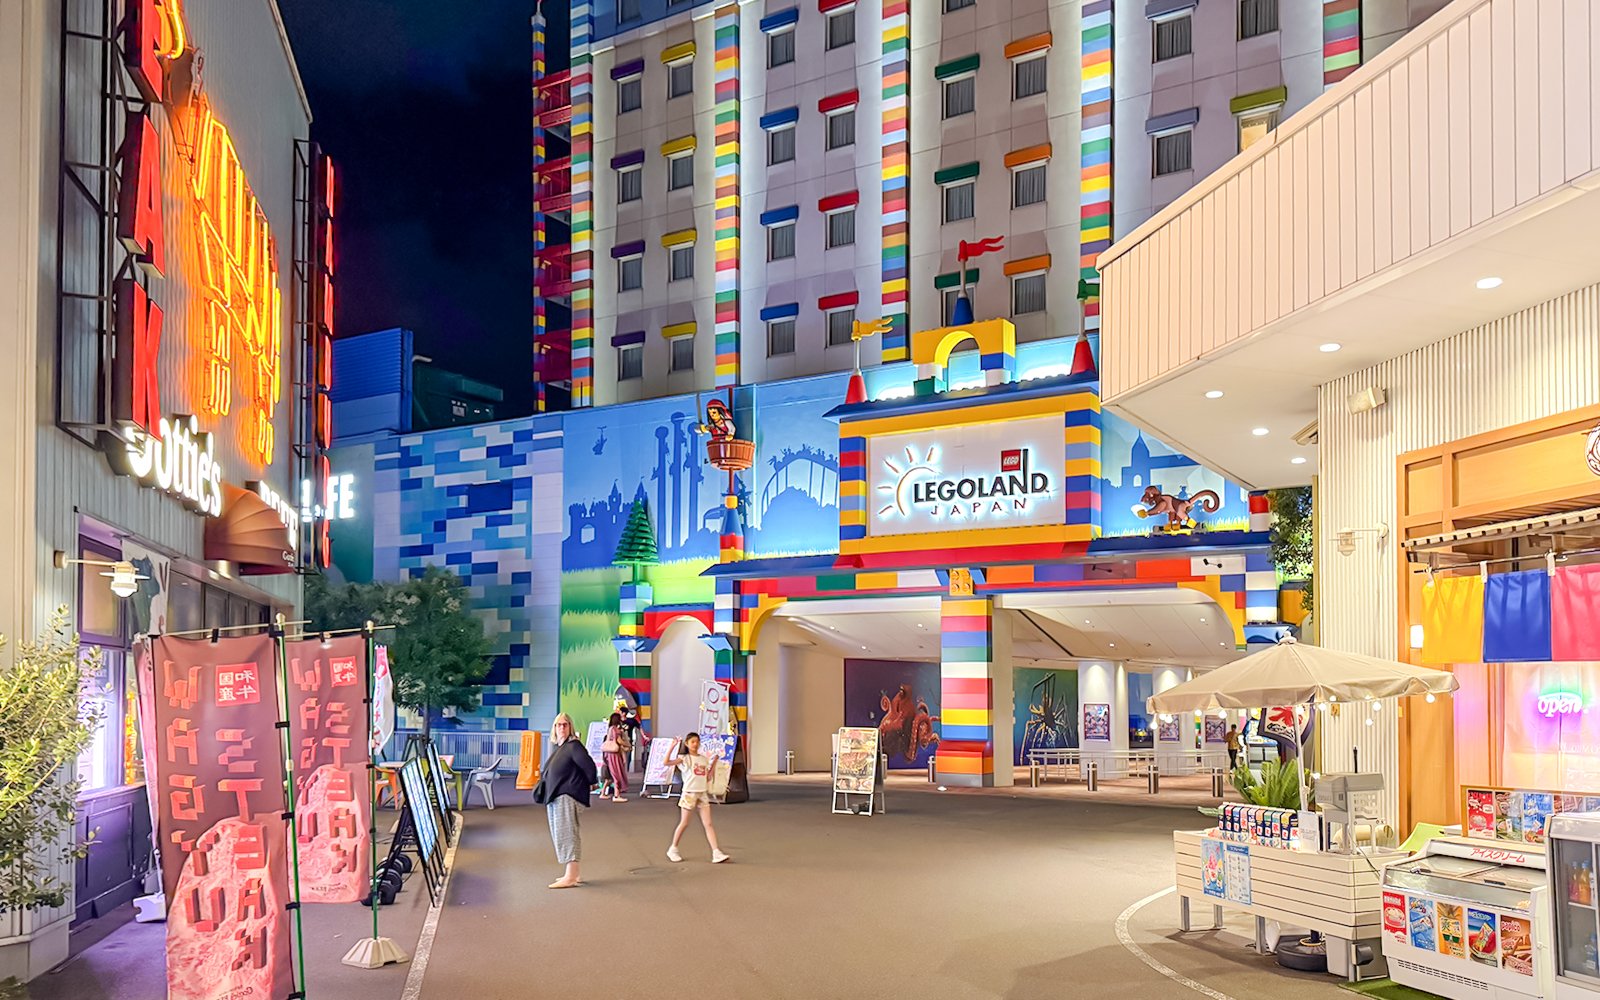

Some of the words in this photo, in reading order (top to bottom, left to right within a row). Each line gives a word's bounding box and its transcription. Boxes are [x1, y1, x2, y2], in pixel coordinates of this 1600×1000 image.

[1003, 455, 1019, 465] LEGO
[914, 448, 1050, 503] LEGOLAND
[931, 497, 1027, 515] JAPAN
[1471, 847, 1526, 863] アイスクリーム
